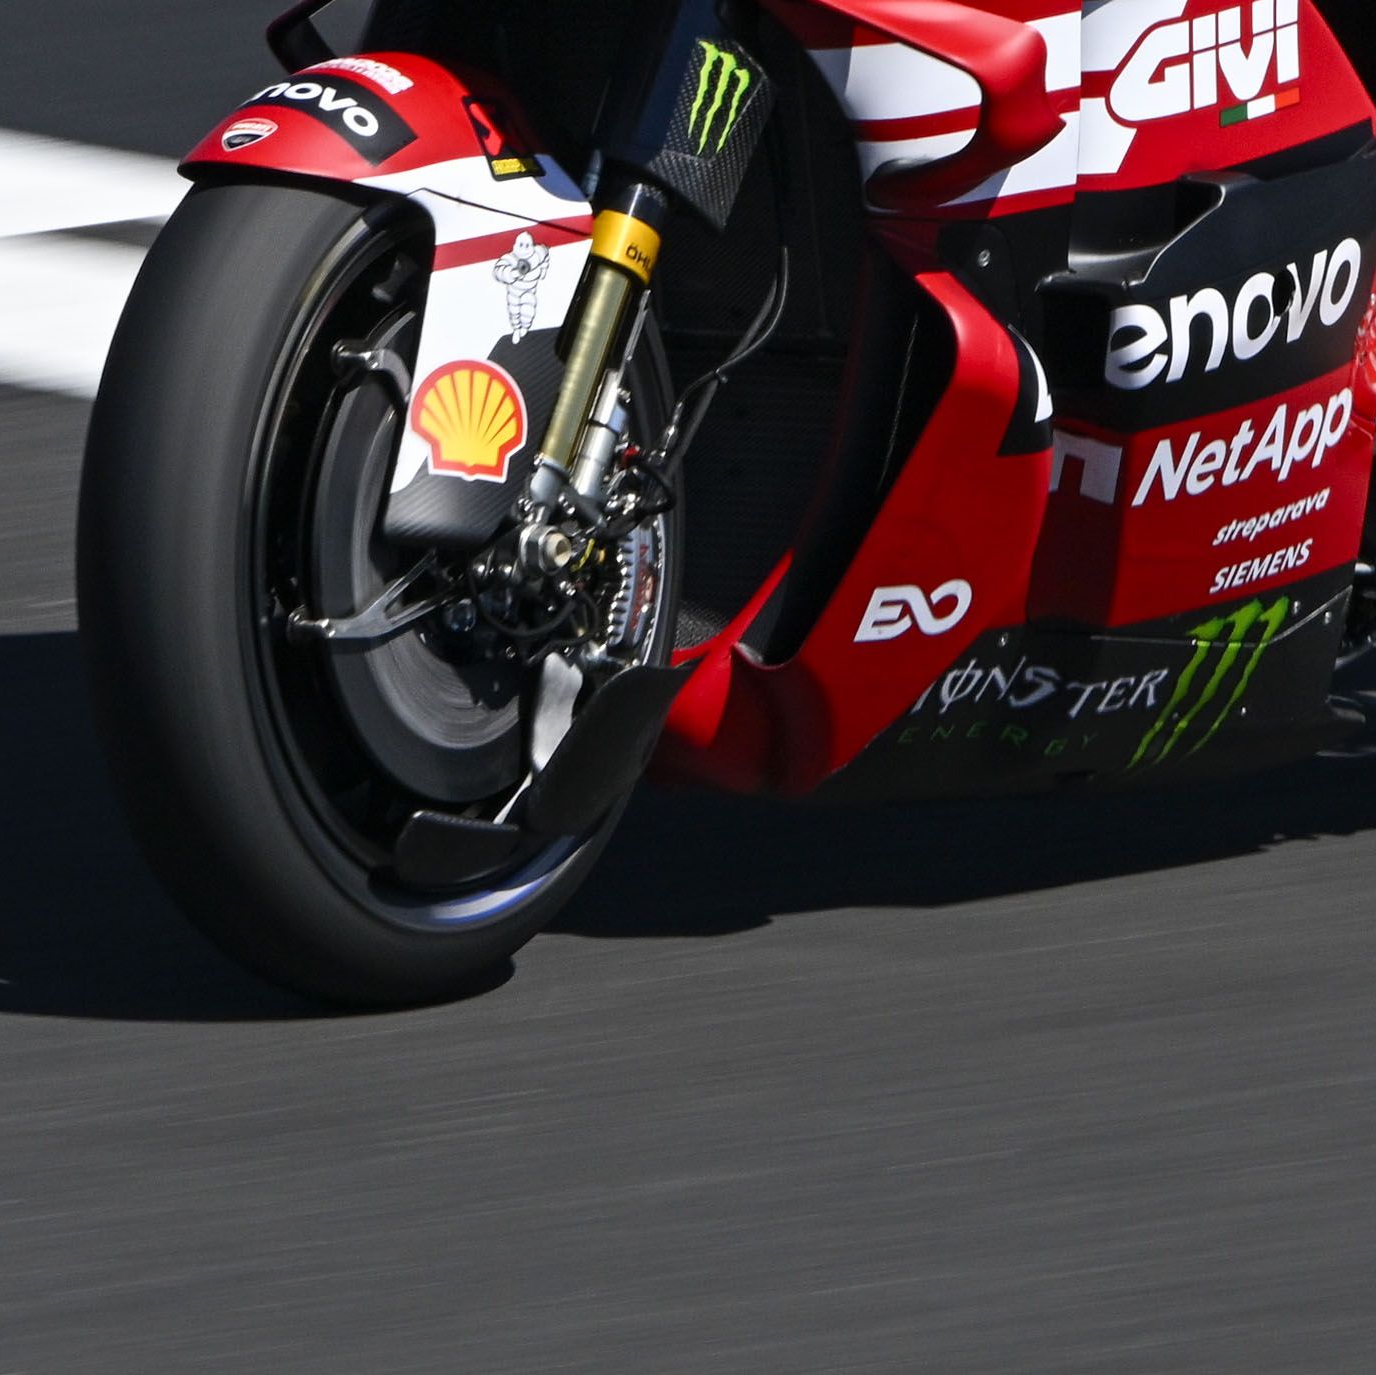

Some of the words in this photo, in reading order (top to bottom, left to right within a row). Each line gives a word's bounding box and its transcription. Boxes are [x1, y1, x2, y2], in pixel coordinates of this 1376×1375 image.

[243, 82, 380, 138] novo
[624, 242, 654, 271] ÖHL
[1103, 236, 1362, 391] enovo
[1131, 387, 1353, 507] NetApp
[1212, 486, 1330, 547] streparava
[1209, 538, 1313, 594] SIEMENS
